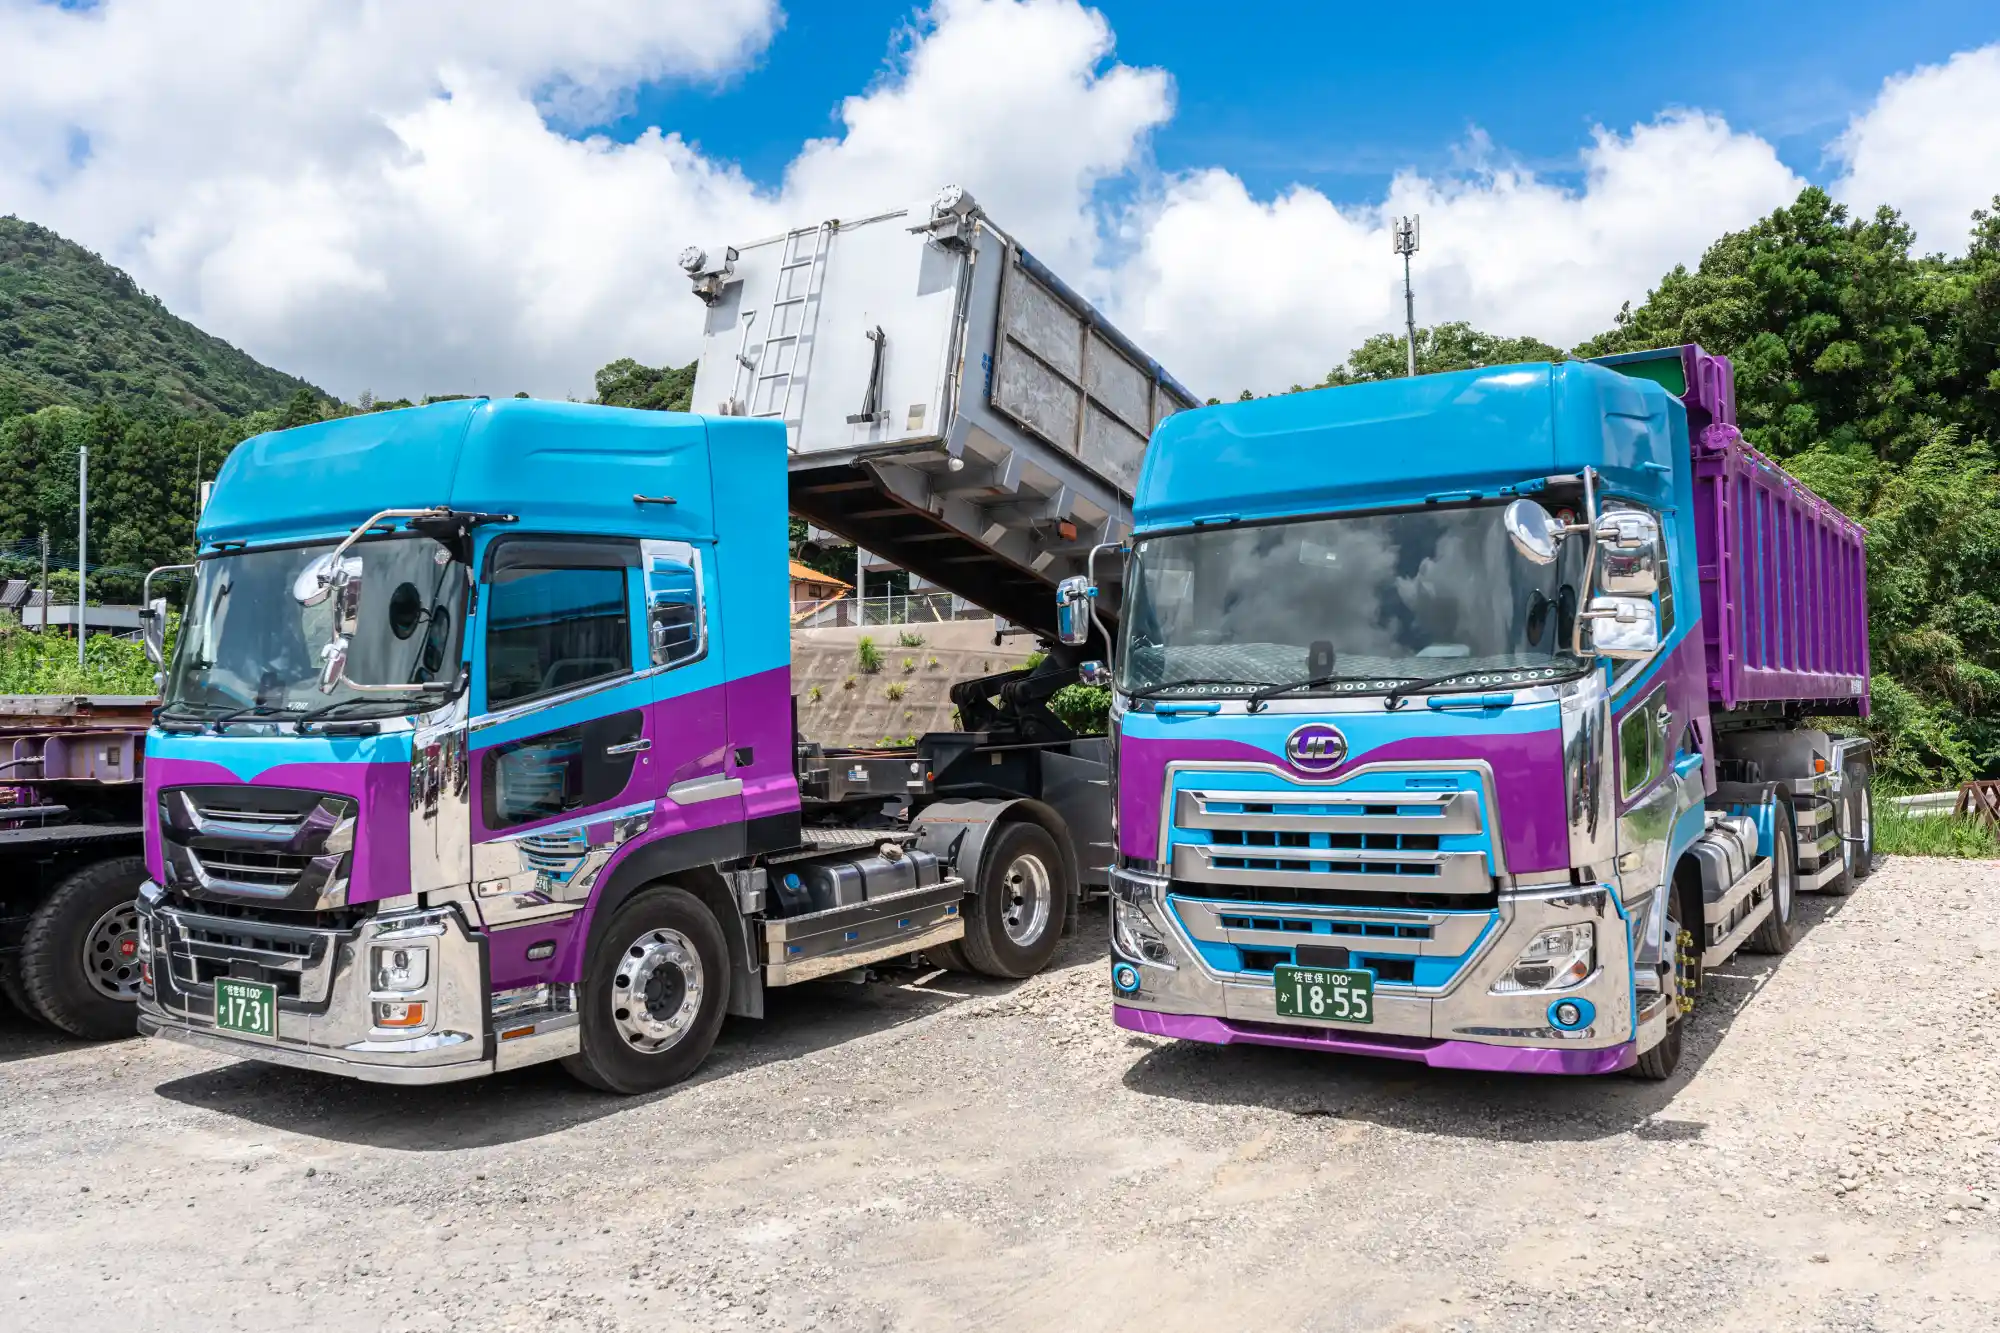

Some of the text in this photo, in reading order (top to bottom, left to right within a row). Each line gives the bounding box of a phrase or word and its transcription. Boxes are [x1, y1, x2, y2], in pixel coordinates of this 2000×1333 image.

[1290, 736, 1341, 759] UD
[228, 997, 268, 1032] 17-31
[1280, 984, 1367, 1019] か 18-55
